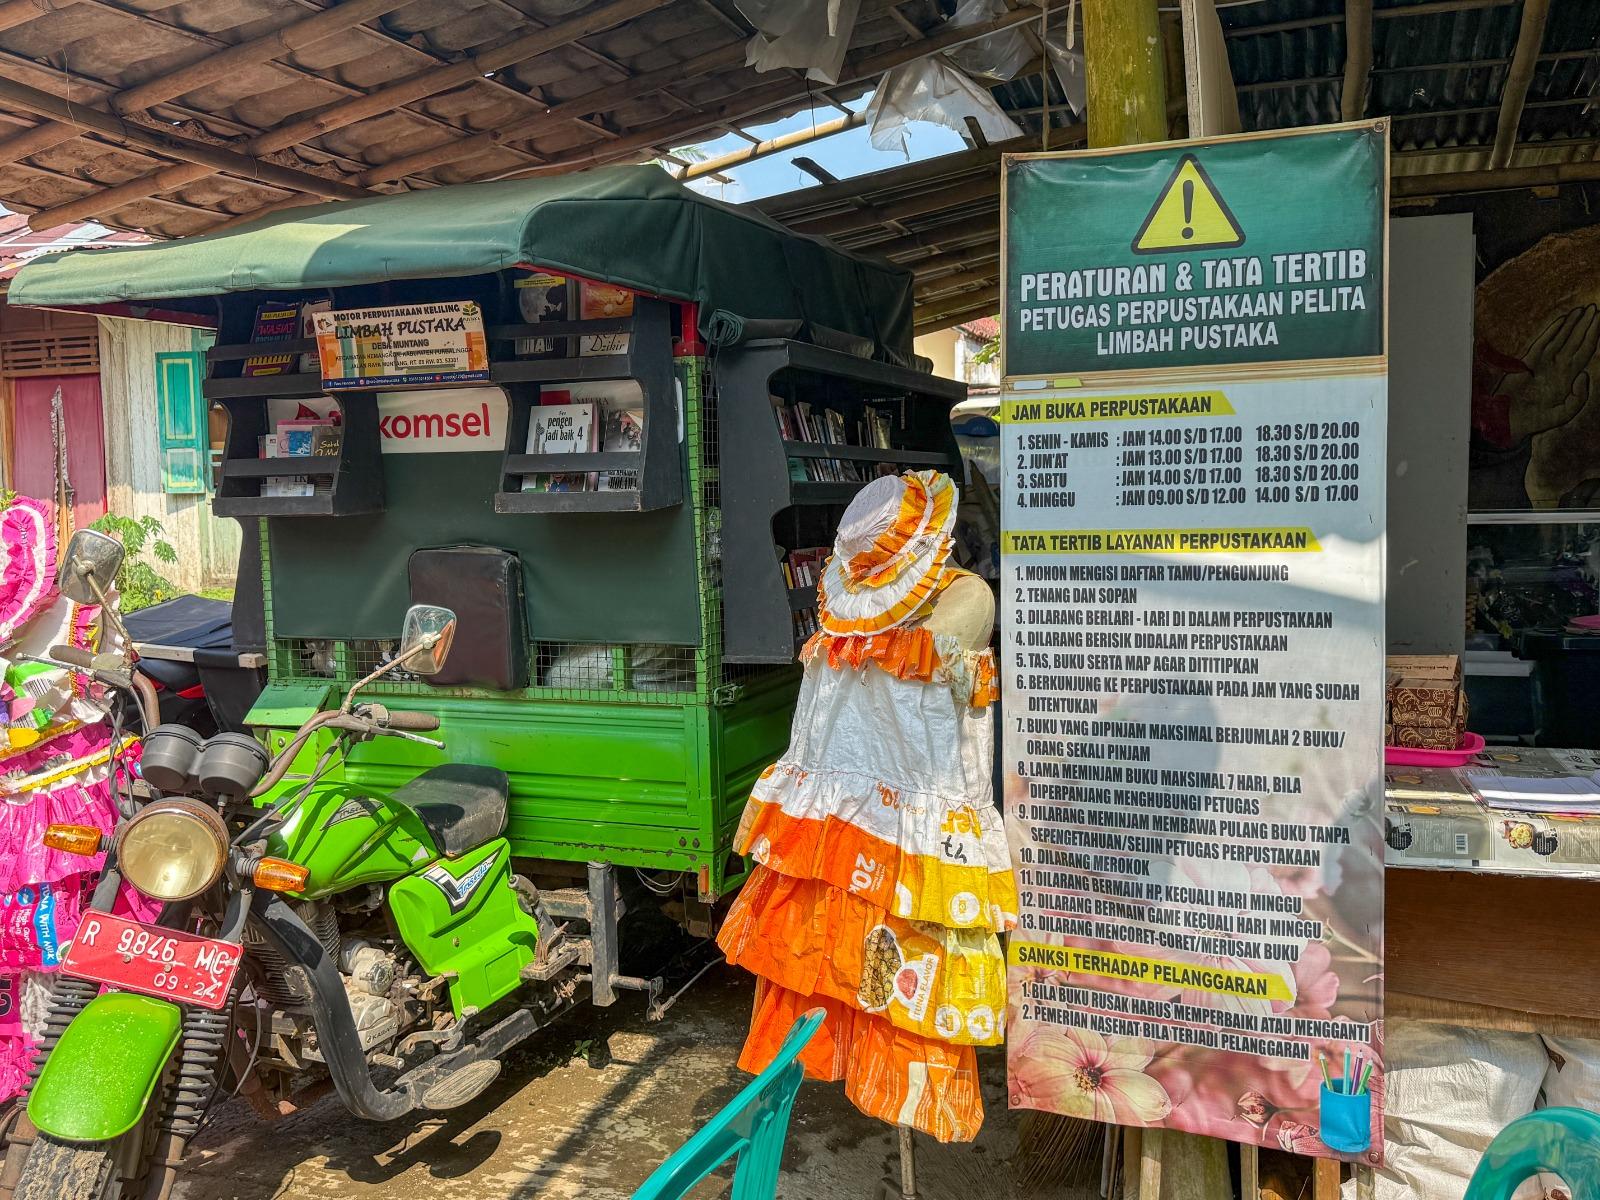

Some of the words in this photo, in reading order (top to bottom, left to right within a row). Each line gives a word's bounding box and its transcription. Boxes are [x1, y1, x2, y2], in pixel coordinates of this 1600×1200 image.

[1020, 264, 1167, 302] PERATURAN
[1176, 262, 1192, 291] &
[1201, 257, 1262, 289] TATA
[1273, 249, 1366, 284] TERTIB
[334, 312, 361, 321] MOTOR
[362, 308, 422, 319] PERPUSTAKAAN
[424, 304, 460, 314] KELILING
[1019, 303, 1110, 332] PETUGAS
[1117, 291, 1283, 326] PERPUSTAKAAN
[1290, 286, 1365, 314] PELITA
[336, 322, 393, 339] LIMBAH
[398, 317, 466, 335] PUSTAKA
[1096, 327, 1173, 355] LIMBAH
[1180, 321, 1279, 351] PUSTAKA
[372, 341, 392, 350] DESA
[393, 339, 429, 348] MUNTANG
[1012, 404, 1041, 420] JAM
[1046, 402, 1086, 419] BUKA
[1090, 396, 1212, 417] PERPUSTAKAAN
[545, 429, 558, 441] jadi
[560, 429, 574, 441] baik
[578, 426, 583, 440] 4
[548, 417, 573, 429] pengen
[1028, 434, 1061, 450] SENIN
[1071, 431, 1109, 449] KAMIS
[1122, 430, 1146, 446] JAM
[1148, 428, 1182, 446] 14.00
[1184, 428, 1207, 444] S/D
[1210, 426, 1242, 444] 17.00
[1256, 424, 1292, 442] 18.30
[1294, 424, 1319, 440] S/D
[1321, 421, 1360, 439] 20.00
[1029, 492, 1076, 508] MINGGU
[1122, 490, 1146, 506] JAM
[1148, 489, 1183, 506] 09.00
[1187, 489, 1209, 505] S/D
[1212, 487, 1246, 504] 12.00
[1255, 486, 1290, 503] 14.00
[1295, 485, 1319, 502] S/D
[1324, 485, 1359, 501] 17.00
[1012, 535, 1046, 551] TATA
[1050, 534, 1101, 550] TERTIB
[1107, 533, 1174, 550] LAYANAN
[1180, 532, 1306, 549] PERPUSTAKAAN
[1026, 566, 1066, 580] MOHON
[1070, 566, 1118, 580] MENGISI
[1121, 566, 1164, 580] DAFTAR
[1168, 565, 1288, 581] TAMU/PENGUNJUNG
[1028, 588, 1070, 602] TENANG
[1073, 588, 1095, 603] DAN
[1099, 588, 1137, 603] SOPAN
[1028, 610, 1083, 625] DILARANG
[1086, 611, 1133, 625] BERLARI
[1144, 611, 1169, 626] LARI
[1173, 611, 1185, 626] DI
[1189, 611, 1230, 627] DALAM
[1234, 612, 1332, 628] PERPUSTAKAAN
[1028, 632, 1082, 647] DILARANG
[1086, 633, 1131, 648] BERISIK
[1135, 634, 1187, 649] DIDALAM
[1192, 634, 1288, 651] PERPUSTAKAAN
[1029, 653, 1052, 670] TAS,
[1054, 654, 1084, 669] BUKU
[1088, 655, 1122, 670] SERTA
[1126, 656, 1150, 671] MAP
[1154, 656, 1185, 672] AGAR
[1189, 657, 1258, 674] DITITIPKAN
[1029, 675, 1100, 692] BERKUNJUNG
[1104, 677, 1118, 692] KE
[1121, 678, 1212, 696] PERPUSTAKAAN
[1217, 681, 1248, 697] PADA
[1252, 682, 1276, 698] JAM
[1279, 683, 1312, 699] YANG
[1316, 684, 1359, 700] SUDAH
[1029, 697, 1097, 713] DITENTUKAN
[1028, 718, 1057, 734] BUKU
[1060, 720, 1088, 736] YANG
[1092, 721, 1146, 738] DIPINJAM
[1150, 724, 1213, 742] MAKSIMAL
[1216, 727, 1288, 745] BERJUMLAH
[1292, 730, 1299, 746] 2
[1303, 731, 1345, 748] BUKU/
[1027, 740, 1063, 757] ORANG
[1067, 742, 1104, 759] SEKALI
[1108, 744, 1150, 761] PINJAM
[1030, 762, 1059, 778] LAMA
[1062, 764, 1122, 782] MEMINJAM
[1126, 768, 1157, 785] BUKU
[1161, 770, 1224, 789] MAKSIMAL
[1228, 774, 1234, 789] 7
[1237, 775, 1270, 793] HARI,
[1273, 777, 1301, 793] BILA
[1031, 784, 1111, 804] DIPERPANJANG
[1114, 790, 1201, 811] MENGHUBUNGI
[1205, 796, 1259, 815] PETUGAS
[1031, 805, 1084, 824] DILARANG
[1088, 810, 1149, 830] MEMINJAM
[1152, 815, 1216, 835] MEMBAWA
[1220, 821, 1267, 839] PULANG
[1272, 824, 1306, 841] BUKU
[1309, 826, 1350, 844] TANPA
[1032, 828, 1162, 854] SEPENGETAHUAN/SEIJIN
[1166, 840, 1219, 858] PETUGAS
[1223, 844, 1320, 866] PERPUSTAKAAN
[1038, 849, 1090, 870] DILARANG
[1093, 856, 1150, 876] MEROKOK
[40, 884, 50, 910] TUNA
[1036, 871, 1089, 891] DILARANG
[1092, 878, 1143, 899] BERMAIN
[1146, 885, 1162, 902] HP,
[1166, 886, 1214, 906] KECUALI
[1218, 891, 1247, 910] HARI
[1251, 894, 1301, 913] MINGGU
[40, 914, 51, 937] WITH
[1038, 893, 1091, 914] DILARANG
[1095, 901, 1144, 921] BERMAIN
[1148, 907, 1180, 926] GAME
[1184, 912, 1233, 932] KECUALI
[1237, 917, 1266, 935] HARI
[1270, 920, 1321, 938] MINGGU
[81, 920, 101, 946] R
[117, 928, 178, 962] 9846
[194, 945, 231, 976] MC
[1039, 915, 1092, 936] DILARANG
[1095, 922, 1261, 959] MENCORET-CORET/MERUSAK
[1264, 943, 1298, 961] BUKU
[1019, 947, 1068, 967] SANKSI
[1073, 953, 1148, 978] TERHADAP
[1154, 965, 1267, 995] PELANGGARAN
[914, 993, 926, 1015] TUNA
[920, 957, 934, 992] FLAVOR
[1032, 983, 1056, 1000] BILA
[1059, 987, 1088, 1005] BUKU
[1092, 992, 1129, 1011] RUSAK
[1132, 999, 1170, 1018] HARUS
[1174, 1004, 1258, 1031] MEMPERBAIKI
[1261, 1017, 1291, 1035] ATAU
[1295, 1019, 1369, 1042] MENGGANTI
[1035, 1007, 1087, 1027] PEMERIAN
[1091, 1016, 1140, 1036] NASEHAT
[1143, 1023, 1169, 1040] BILA
[1172, 1026, 1218, 1048] TERJADI
[1222, 1034, 1309, 1059] PELANGGARAN
